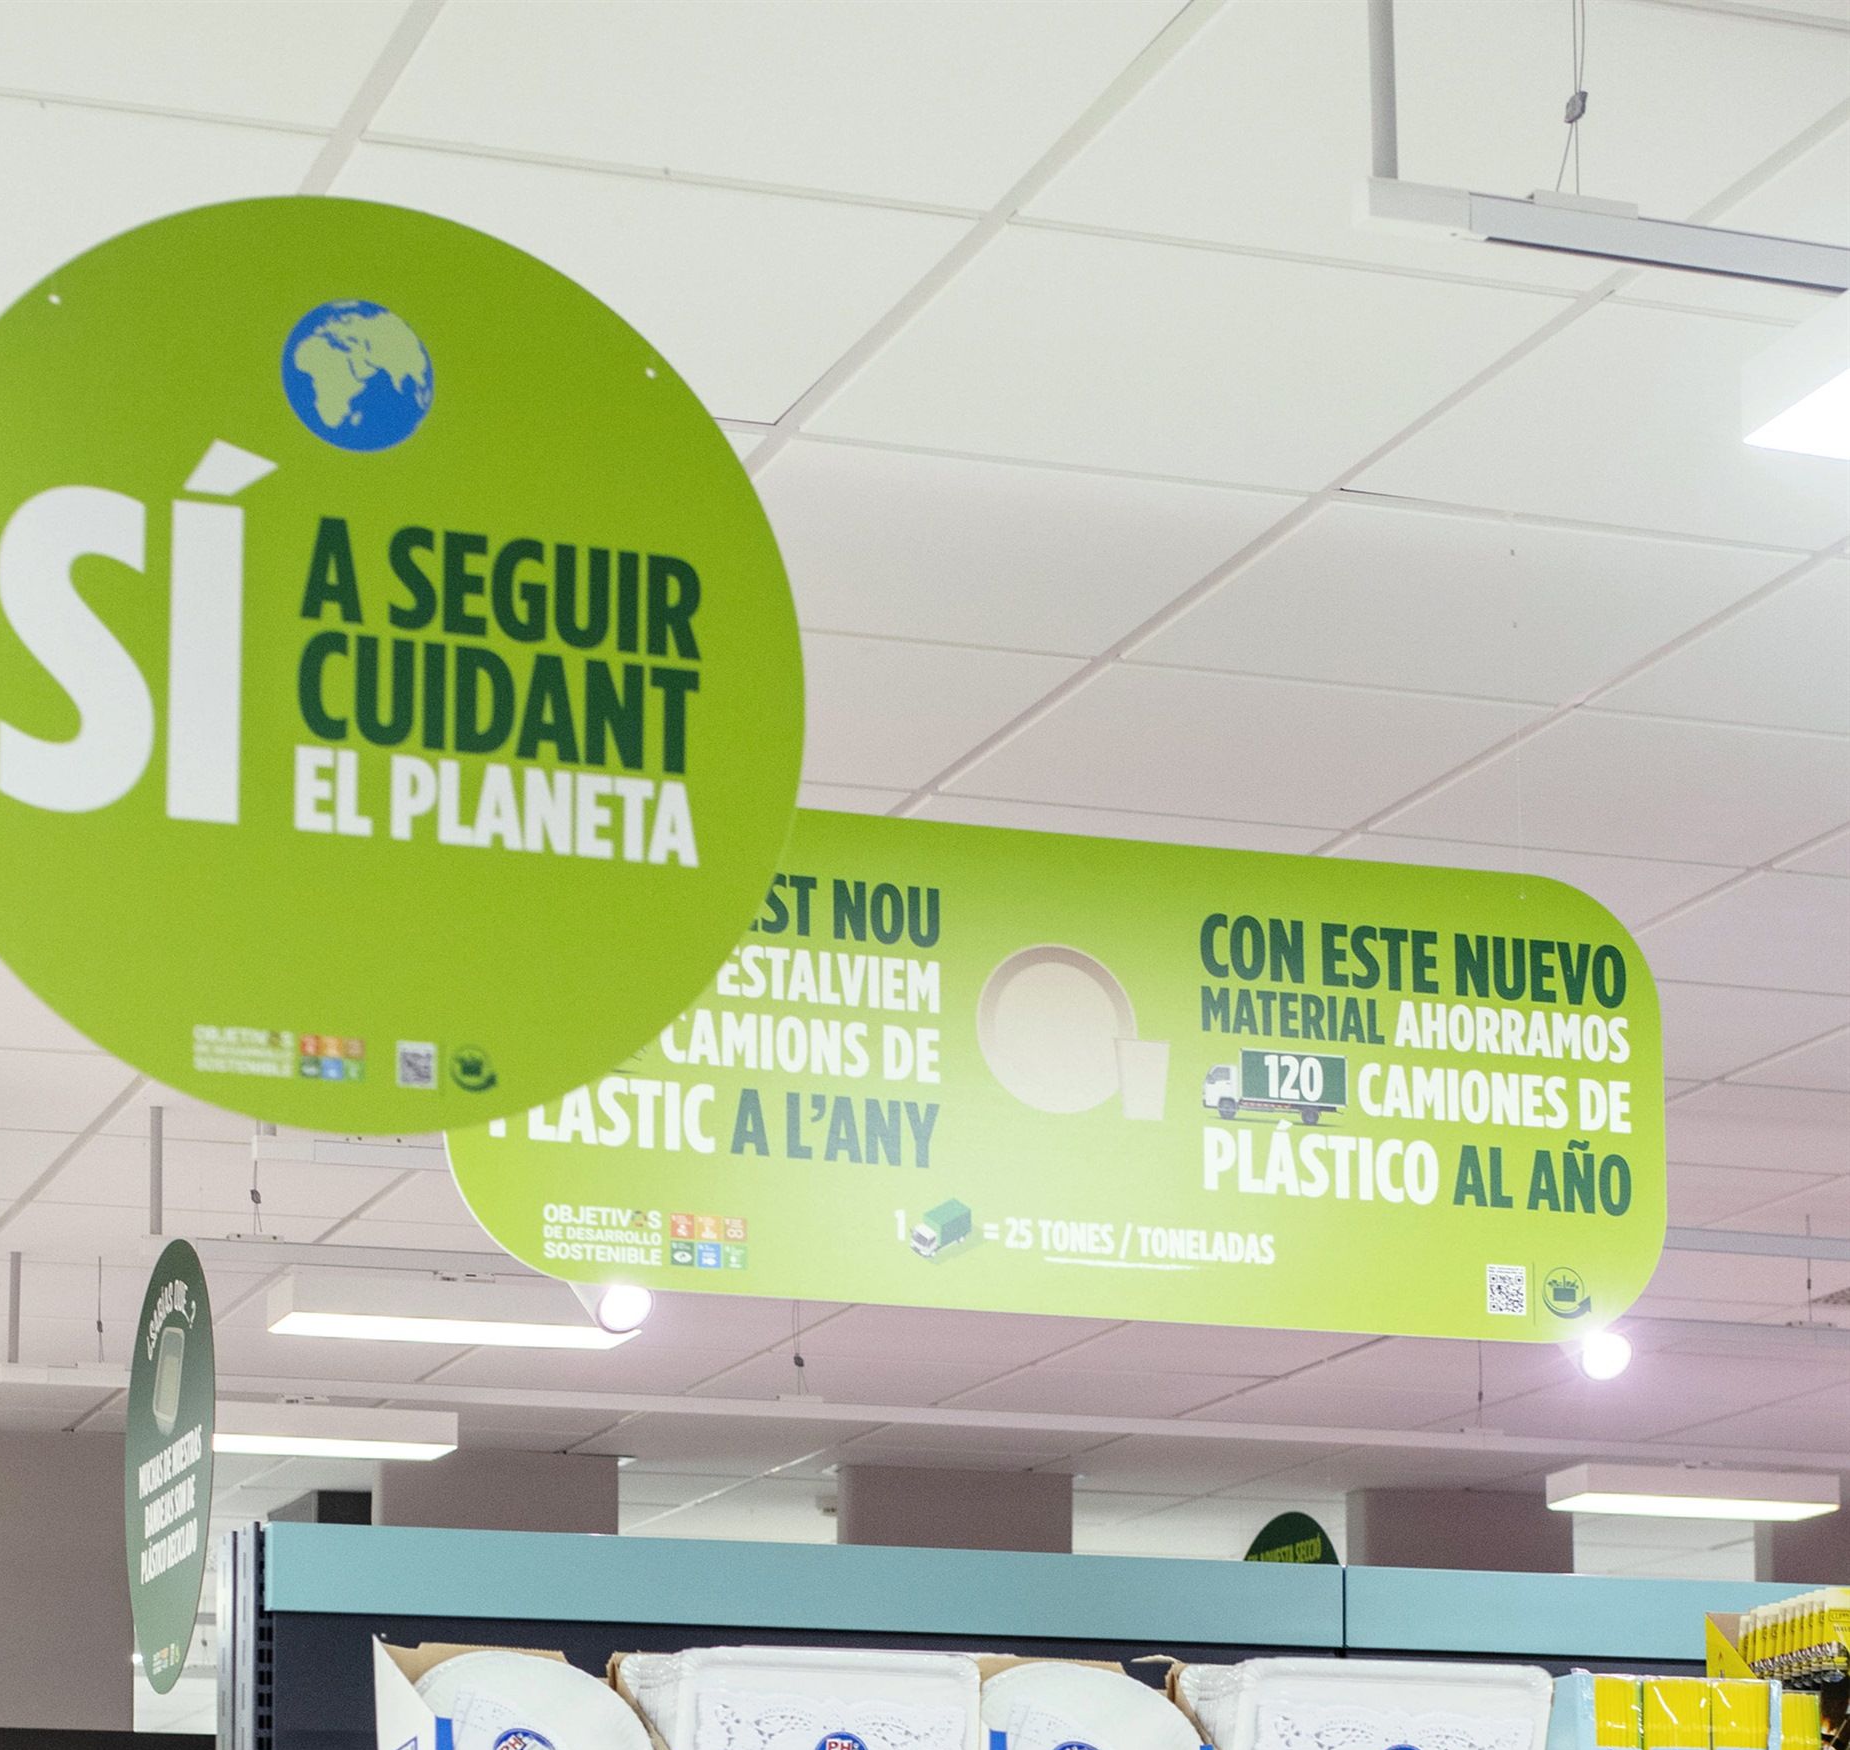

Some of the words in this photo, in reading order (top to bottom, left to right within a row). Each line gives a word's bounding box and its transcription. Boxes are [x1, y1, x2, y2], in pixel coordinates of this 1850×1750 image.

[300, 516, 363, 626] A
[386, 525, 702, 660] SEGUIR
[297, 631, 700, 774] CUIDANT
[294, 743, 373, 837] EL
[390, 752, 699, 868] PLANETA
[833, 879, 940, 948] NOU
[716, 944, 940, 1014] ESTALVIEM
[1200, 913, 1304, 984] CON
[1321, 922, 1439, 995] ESTE
[1454, 932, 1627, 1009] NUEVO
[660, 1008, 869, 1073] CAMIONS
[883, 1025, 940, 1084] DE
[1201, 986, 1385, 1045] MATERIAL
[1394, 1001, 1631, 1064] AHORRAMOS
[489, 1076, 715, 1154] LASTIC
[730, 1088, 769, 1157] A
[1264, 1054, 1323, 1102] 120
[1357, 1062, 1569, 1130] CAMIONES
[1579, 1078, 1632, 1134] DE
[1203, 1119, 1440, 1206] PLÁSTICO
[1453, 1144, 1513, 1209] AL
[1526, 1139, 1632, 1217] AÑO
[543, 1225, 563, 1239] DE
[566, 1226, 662, 1246] DESARROLLO
[543, 1242, 662, 1266] SOSTENIBLE
[893, 1209, 906, 1239] 1
[1005, 1219, 1032, 1249] 25
[1041, 1220, 1115, 1258] TONES
[1137, 1226, 1275, 1265] TONELADAS
